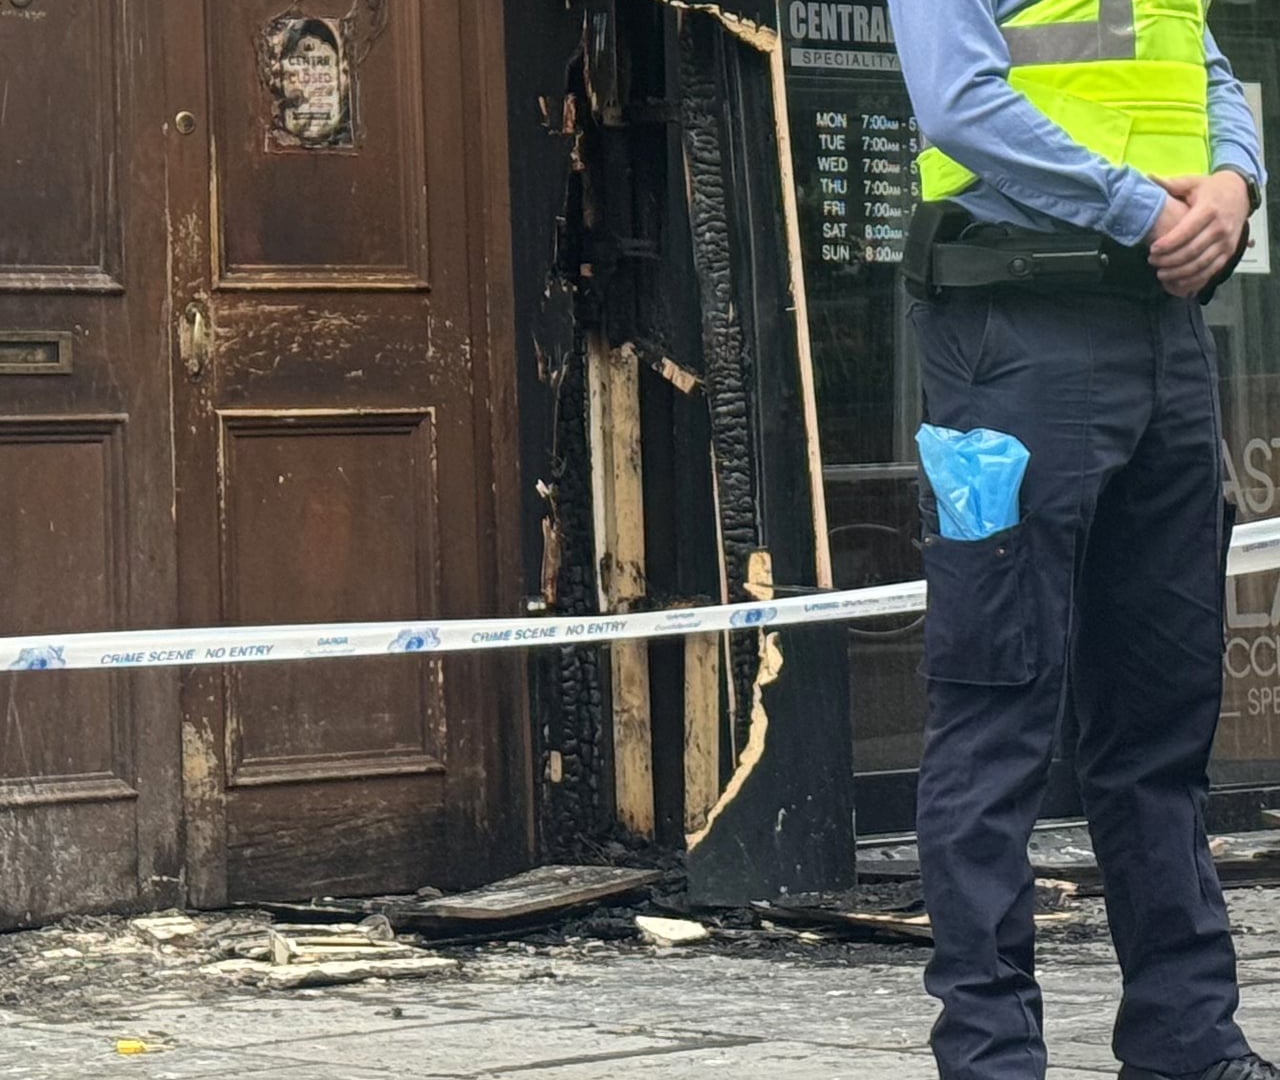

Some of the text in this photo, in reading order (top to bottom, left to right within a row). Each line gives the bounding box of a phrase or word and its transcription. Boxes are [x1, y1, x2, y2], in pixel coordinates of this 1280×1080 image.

[803, 51, 895, 69] SPECIALITY
[816, 112, 847, 128] MON
[819, 134, 845, 150] TUE
[817, 156, 848, 172] WED
[820, 179, 847, 194] THU
[823, 200, 845, 216] FRI
[823, 223, 848, 238] SAT
[822, 245, 849, 260] SUN
[471, 620, 628, 643] CRIME SCENE NO ENTRY
[100, 644, 274, 665] CRIME SCENE NO ENTRY
